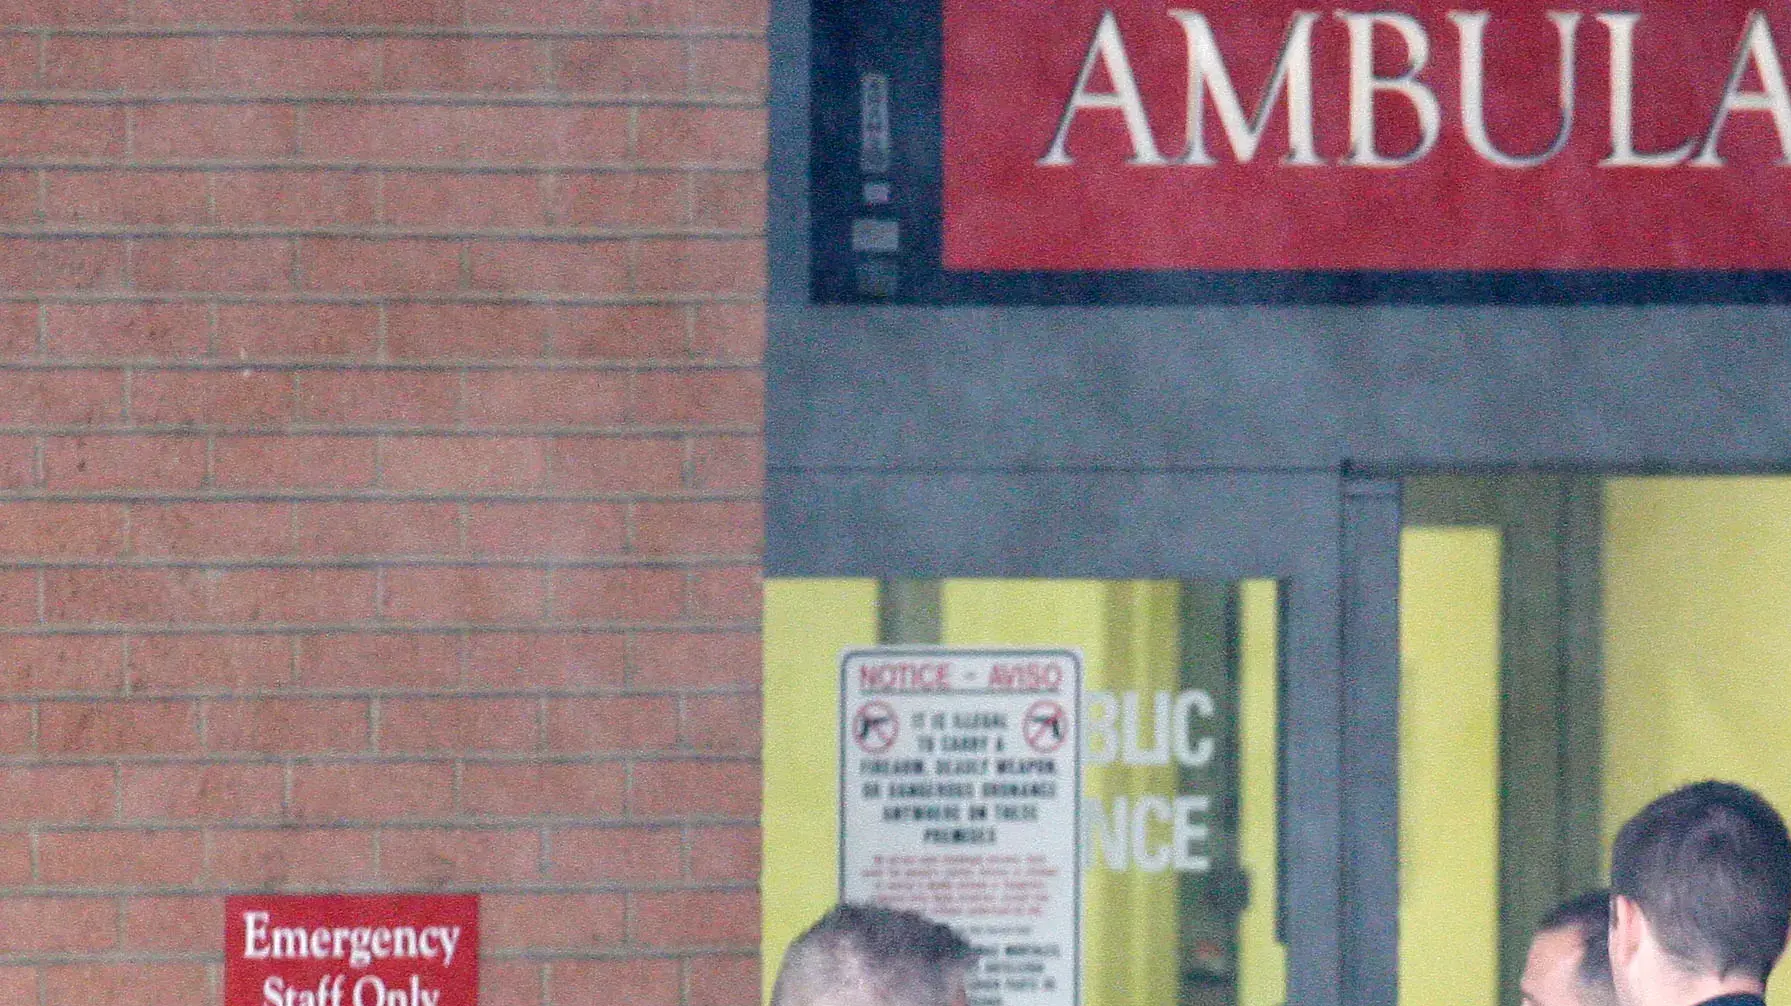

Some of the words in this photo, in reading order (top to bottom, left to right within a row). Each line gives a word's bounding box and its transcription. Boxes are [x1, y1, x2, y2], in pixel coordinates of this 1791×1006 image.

[860, 663, 949, 687] NOTICE
[988, 663, 1063, 687] AVISO
[953, 712, 1007, 729] ILLEGAL
[942, 736, 988, 752] CARRY
[889, 782, 974, 798] DANGEROUS
[243, 911, 460, 968] Emergency
